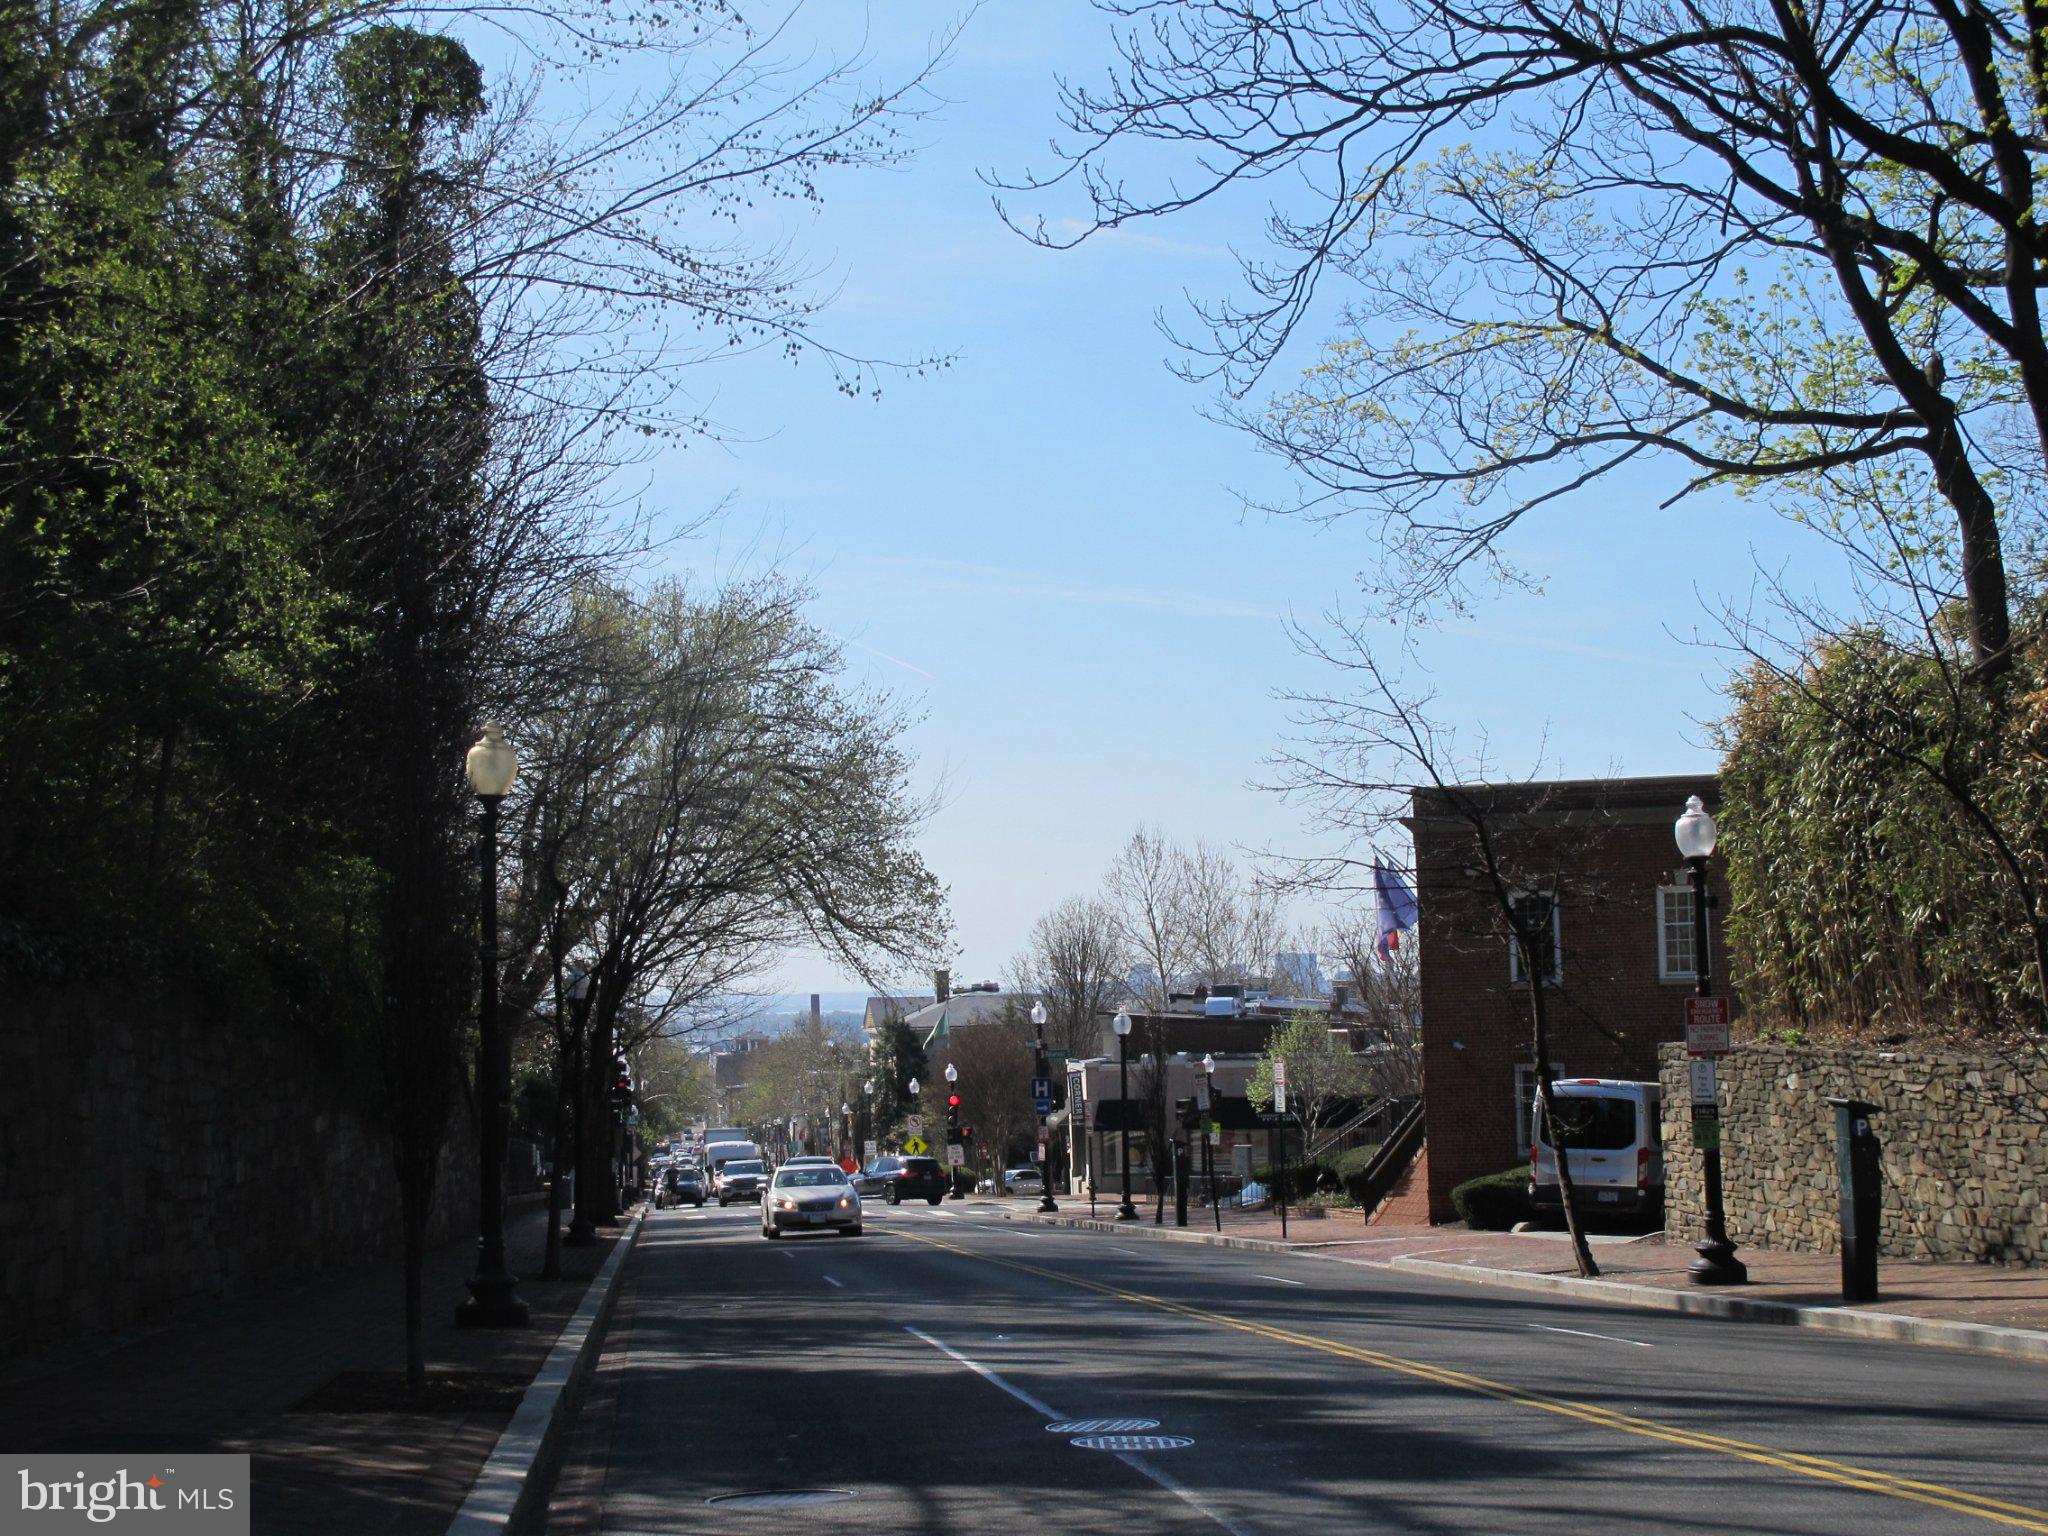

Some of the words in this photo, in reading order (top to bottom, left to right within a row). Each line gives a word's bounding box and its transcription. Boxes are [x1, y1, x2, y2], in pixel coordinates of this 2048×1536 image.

[1694, 999, 1719, 1009] SNOW
[1693, 1014, 1721, 1024] ROUTE
[1035, 1080, 1049, 1097] H
[1072, 1077, 1083, 1114] CORNER
[1857, 1119, 1868, 1136] P
